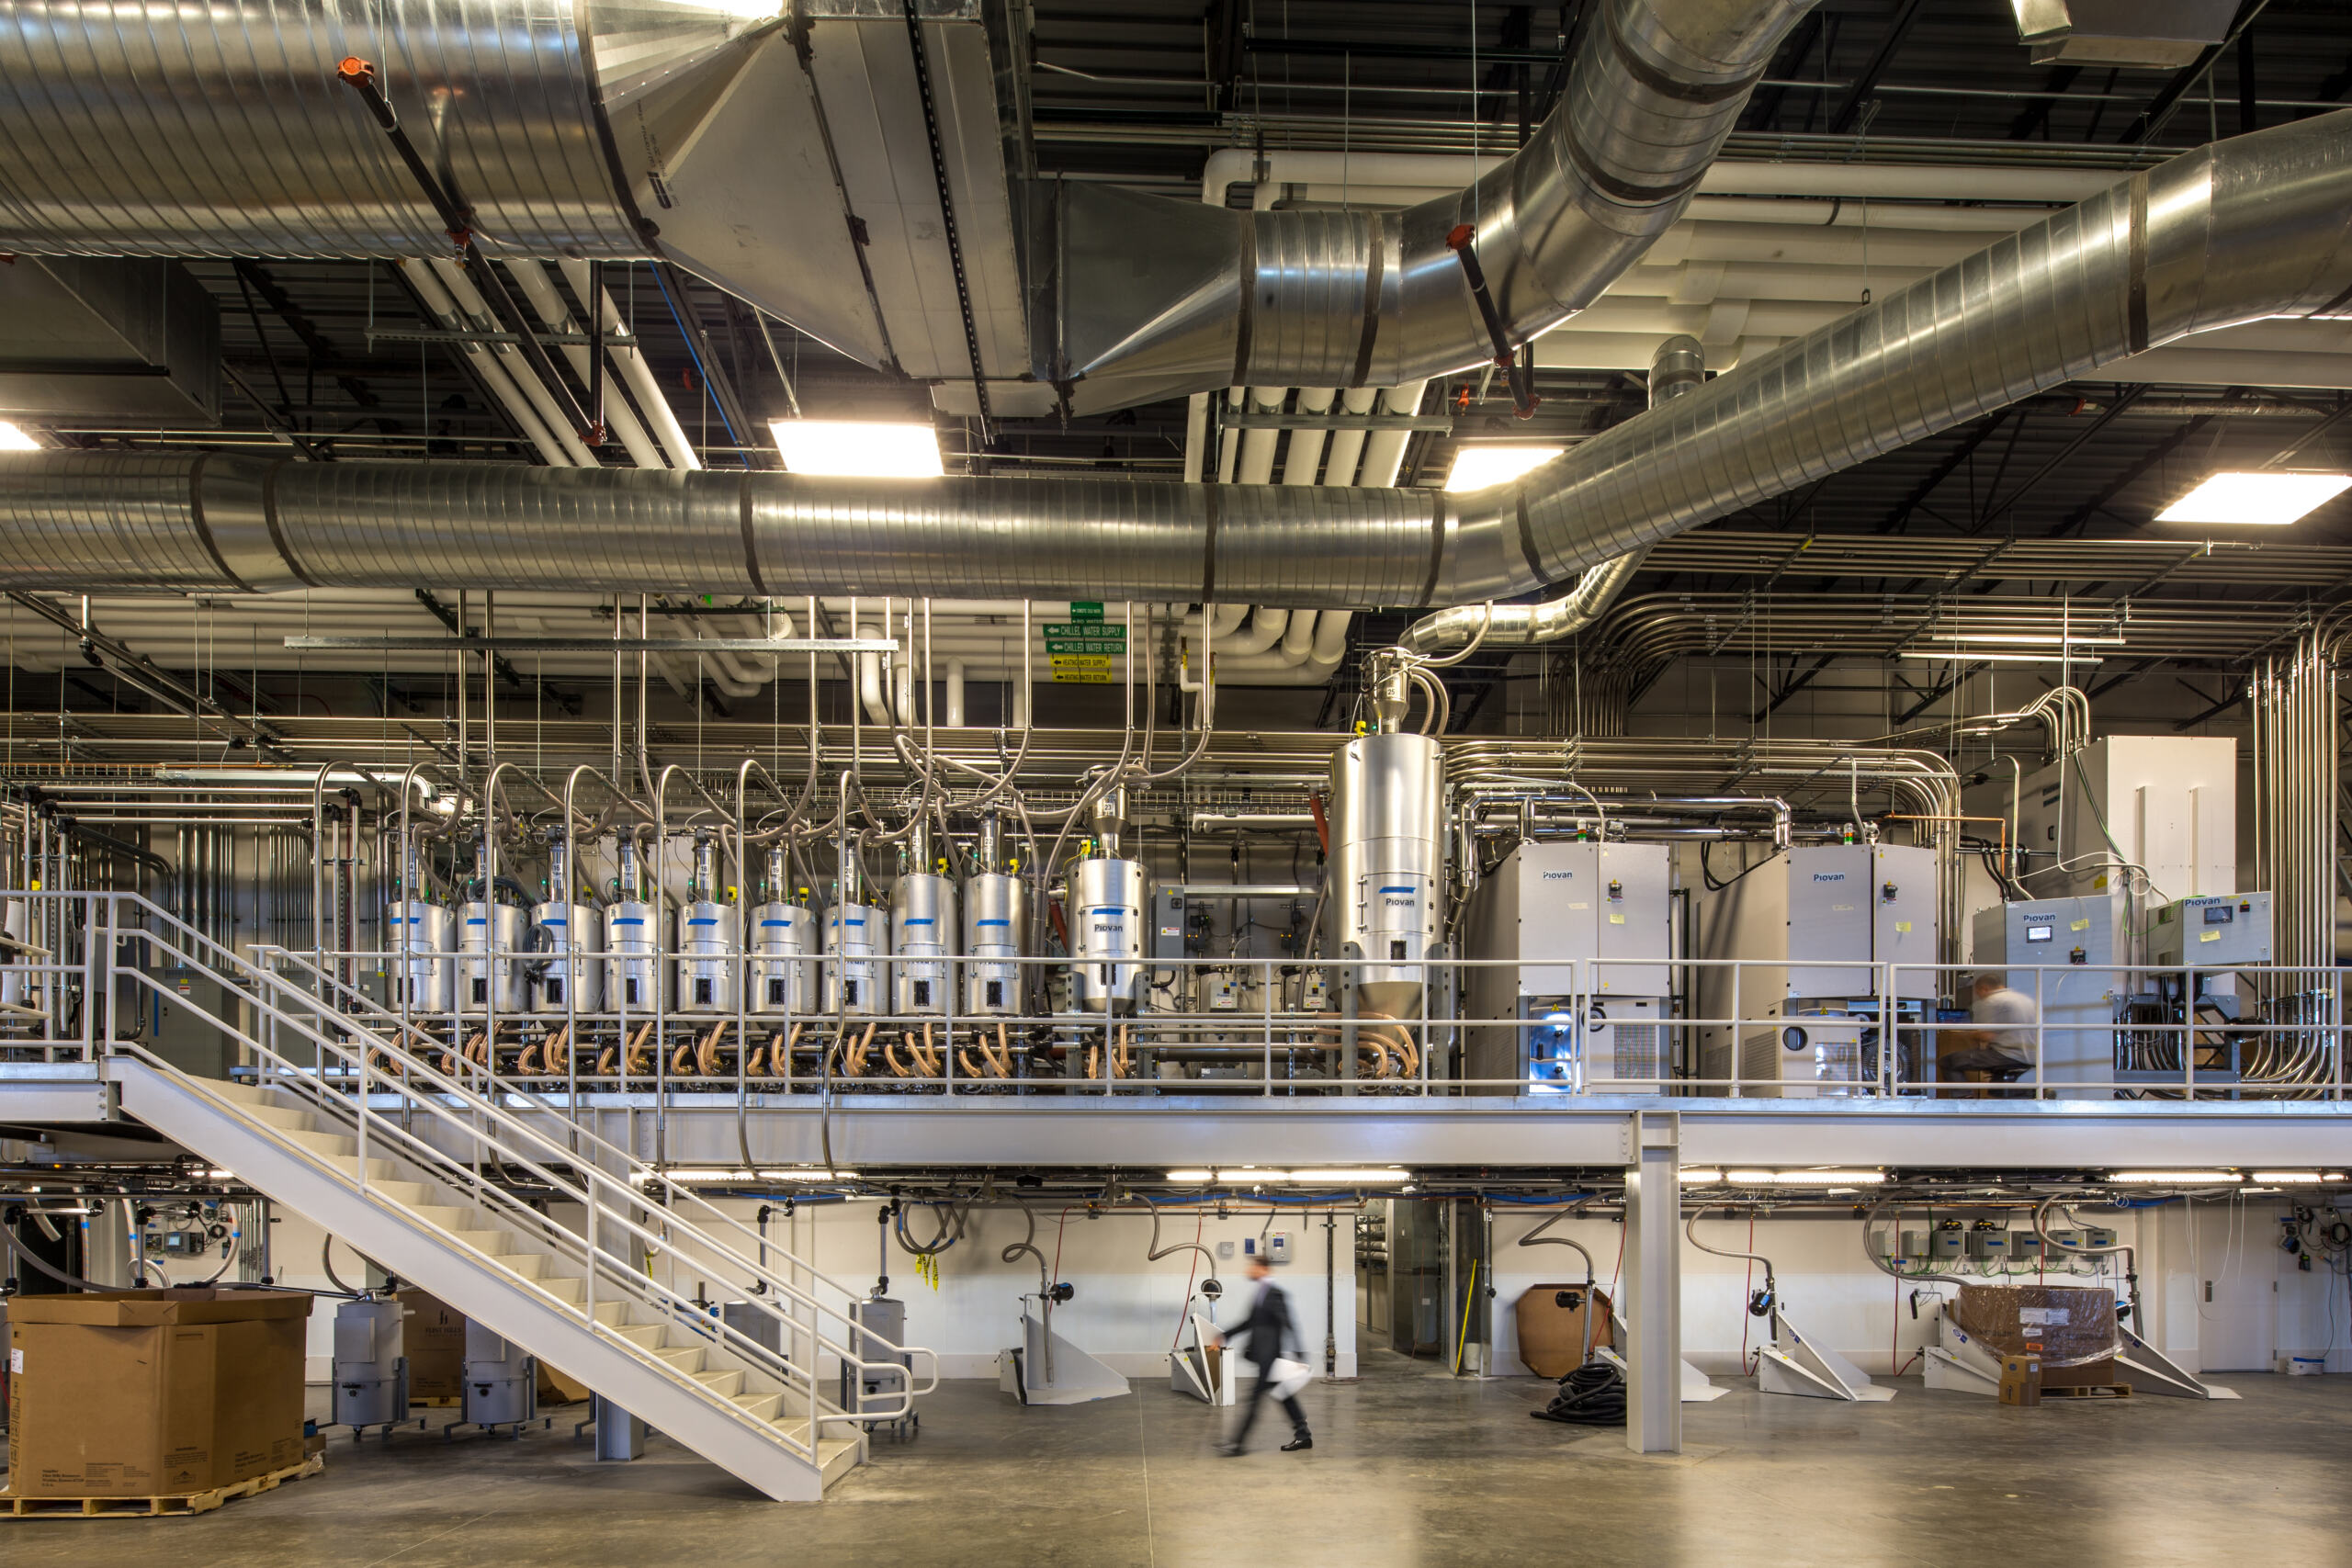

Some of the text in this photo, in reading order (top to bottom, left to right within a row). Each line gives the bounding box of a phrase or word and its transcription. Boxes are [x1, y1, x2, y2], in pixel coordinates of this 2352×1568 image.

[1083, 626, 1101, 636] WATER
[1102, 626, 1121, 636] SUPPLY
[1064, 643, 1123, 652] CHILLED WATER RETURN
[2023, 914, 2056, 922] Piovan
[1094, 924, 1123, 932] Piovan
